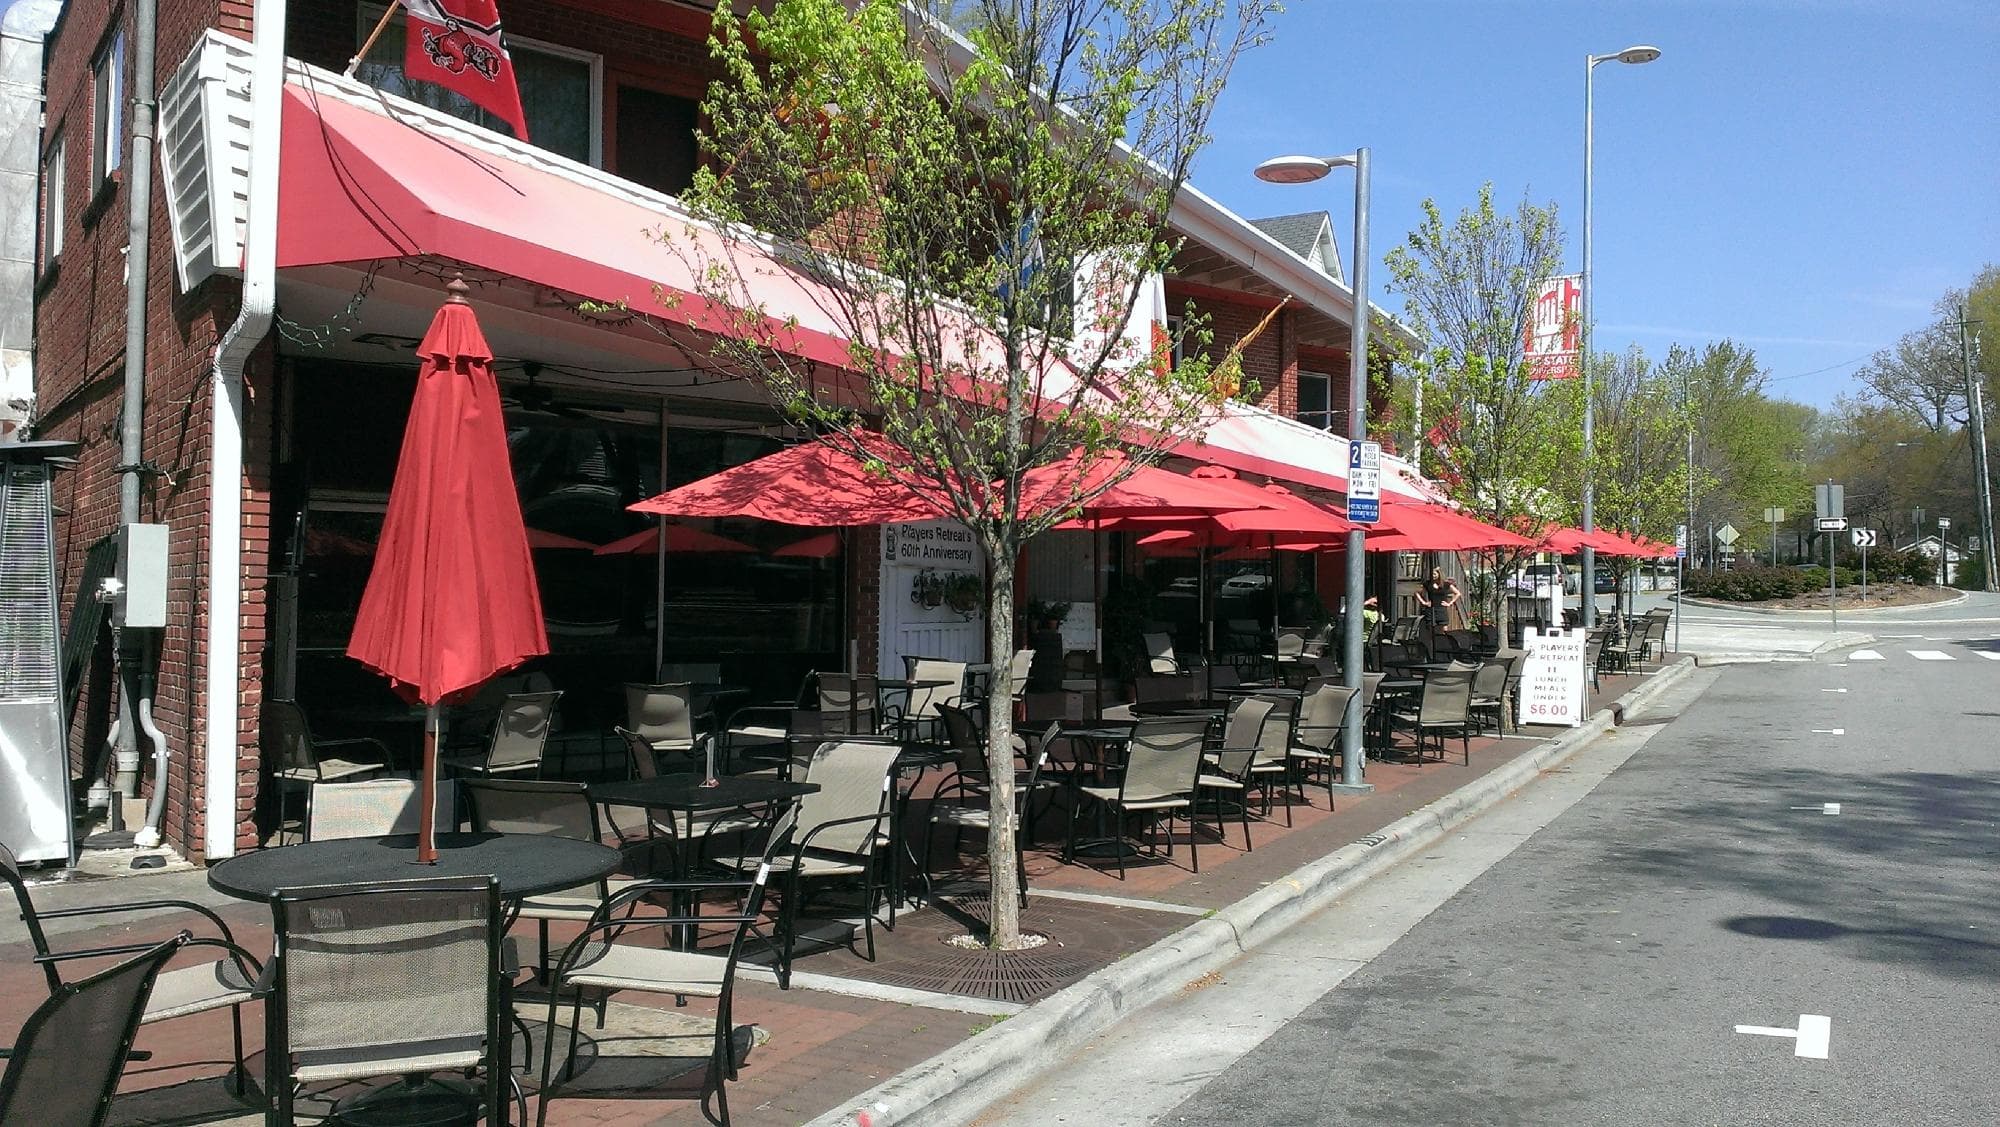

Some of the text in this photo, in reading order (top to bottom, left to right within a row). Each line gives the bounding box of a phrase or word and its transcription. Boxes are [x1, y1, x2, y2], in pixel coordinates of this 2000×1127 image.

[1351, 445, 1359, 464] 2
[902, 524, 972, 542] Players Retreat's
[901, 543, 973, 564] 60th Anniversary
[1540, 644, 1579, 652] PLAYERS
[1539, 654, 1579, 662] RETREAT
[1530, 703, 1568, 716] $6.00
